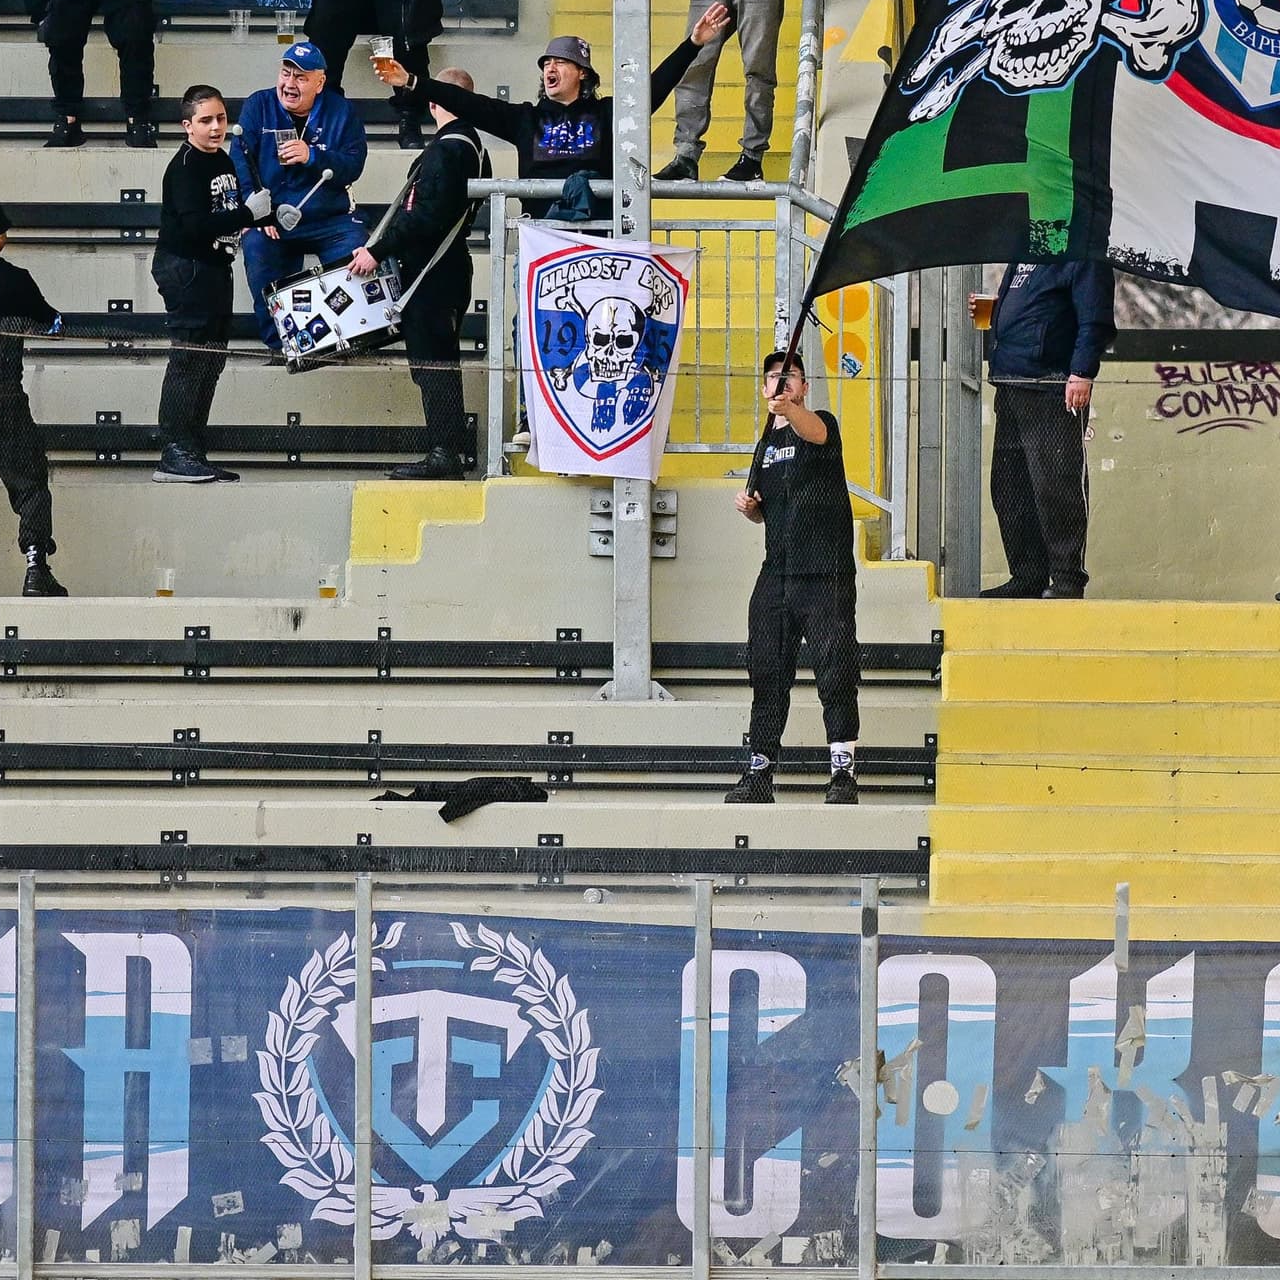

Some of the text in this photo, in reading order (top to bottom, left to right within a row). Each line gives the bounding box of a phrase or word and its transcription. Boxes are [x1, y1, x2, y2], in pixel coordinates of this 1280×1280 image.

[539, 256, 675, 316] MLADOST BOYS
[542, 319, 577, 354] 19
